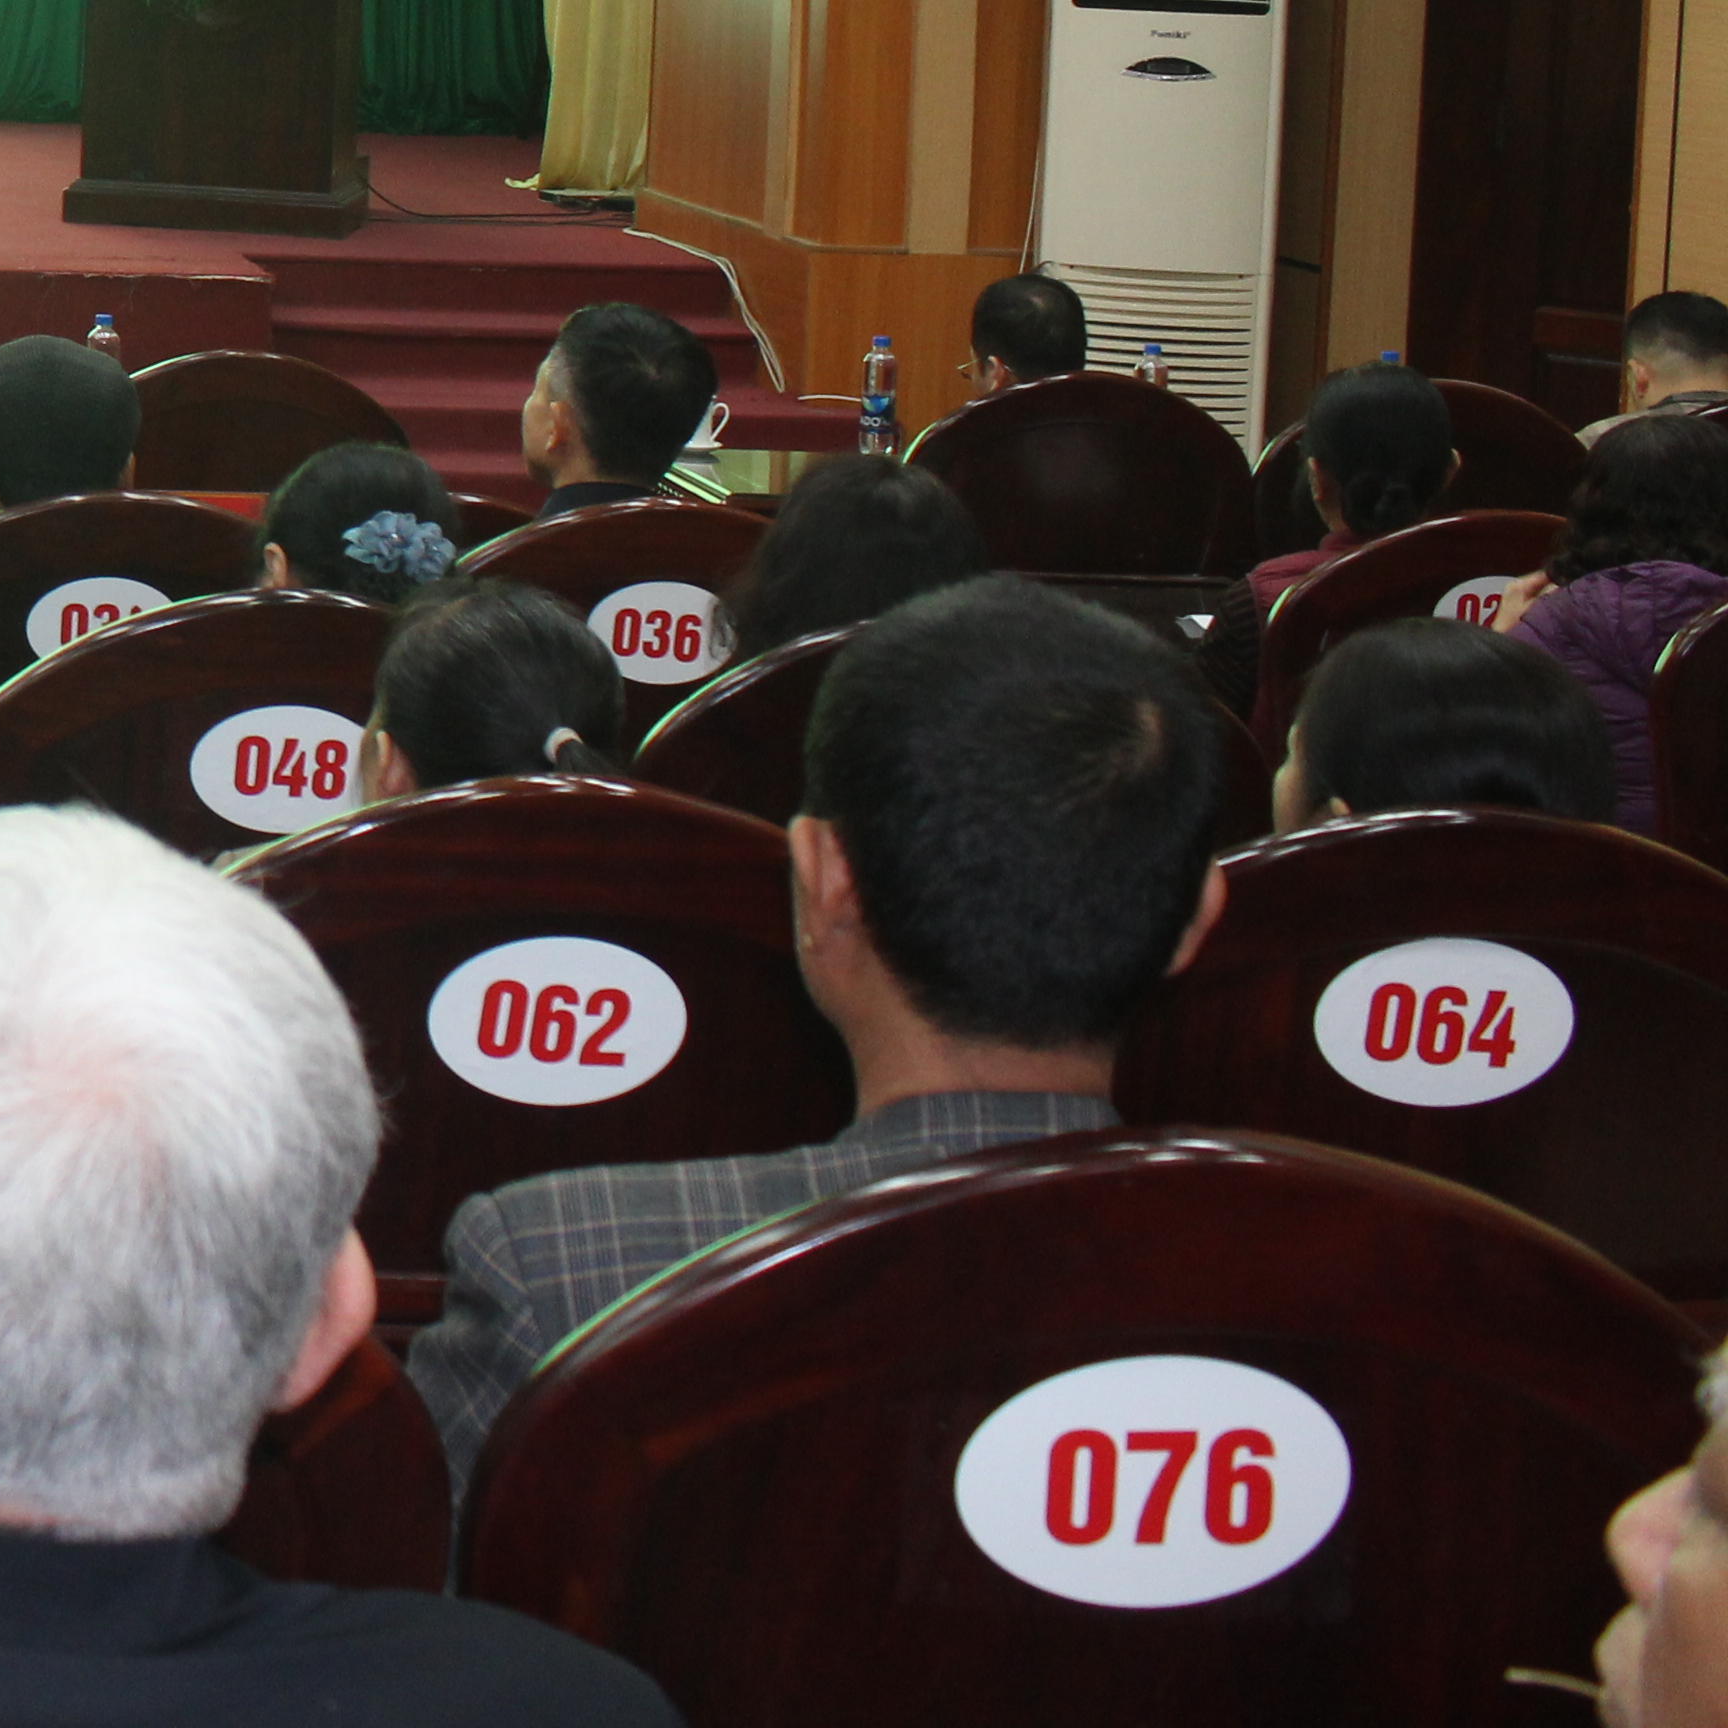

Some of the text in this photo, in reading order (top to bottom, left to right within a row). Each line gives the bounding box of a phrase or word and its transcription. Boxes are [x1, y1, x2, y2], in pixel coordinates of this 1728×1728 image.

[613, 608, 701, 661] 036
[235, 736, 347, 798] 048
[479, 980, 629, 1065] 062
[1366, 983, 1515, 1067] 064
[1047, 1429, 1274, 1544] 076
